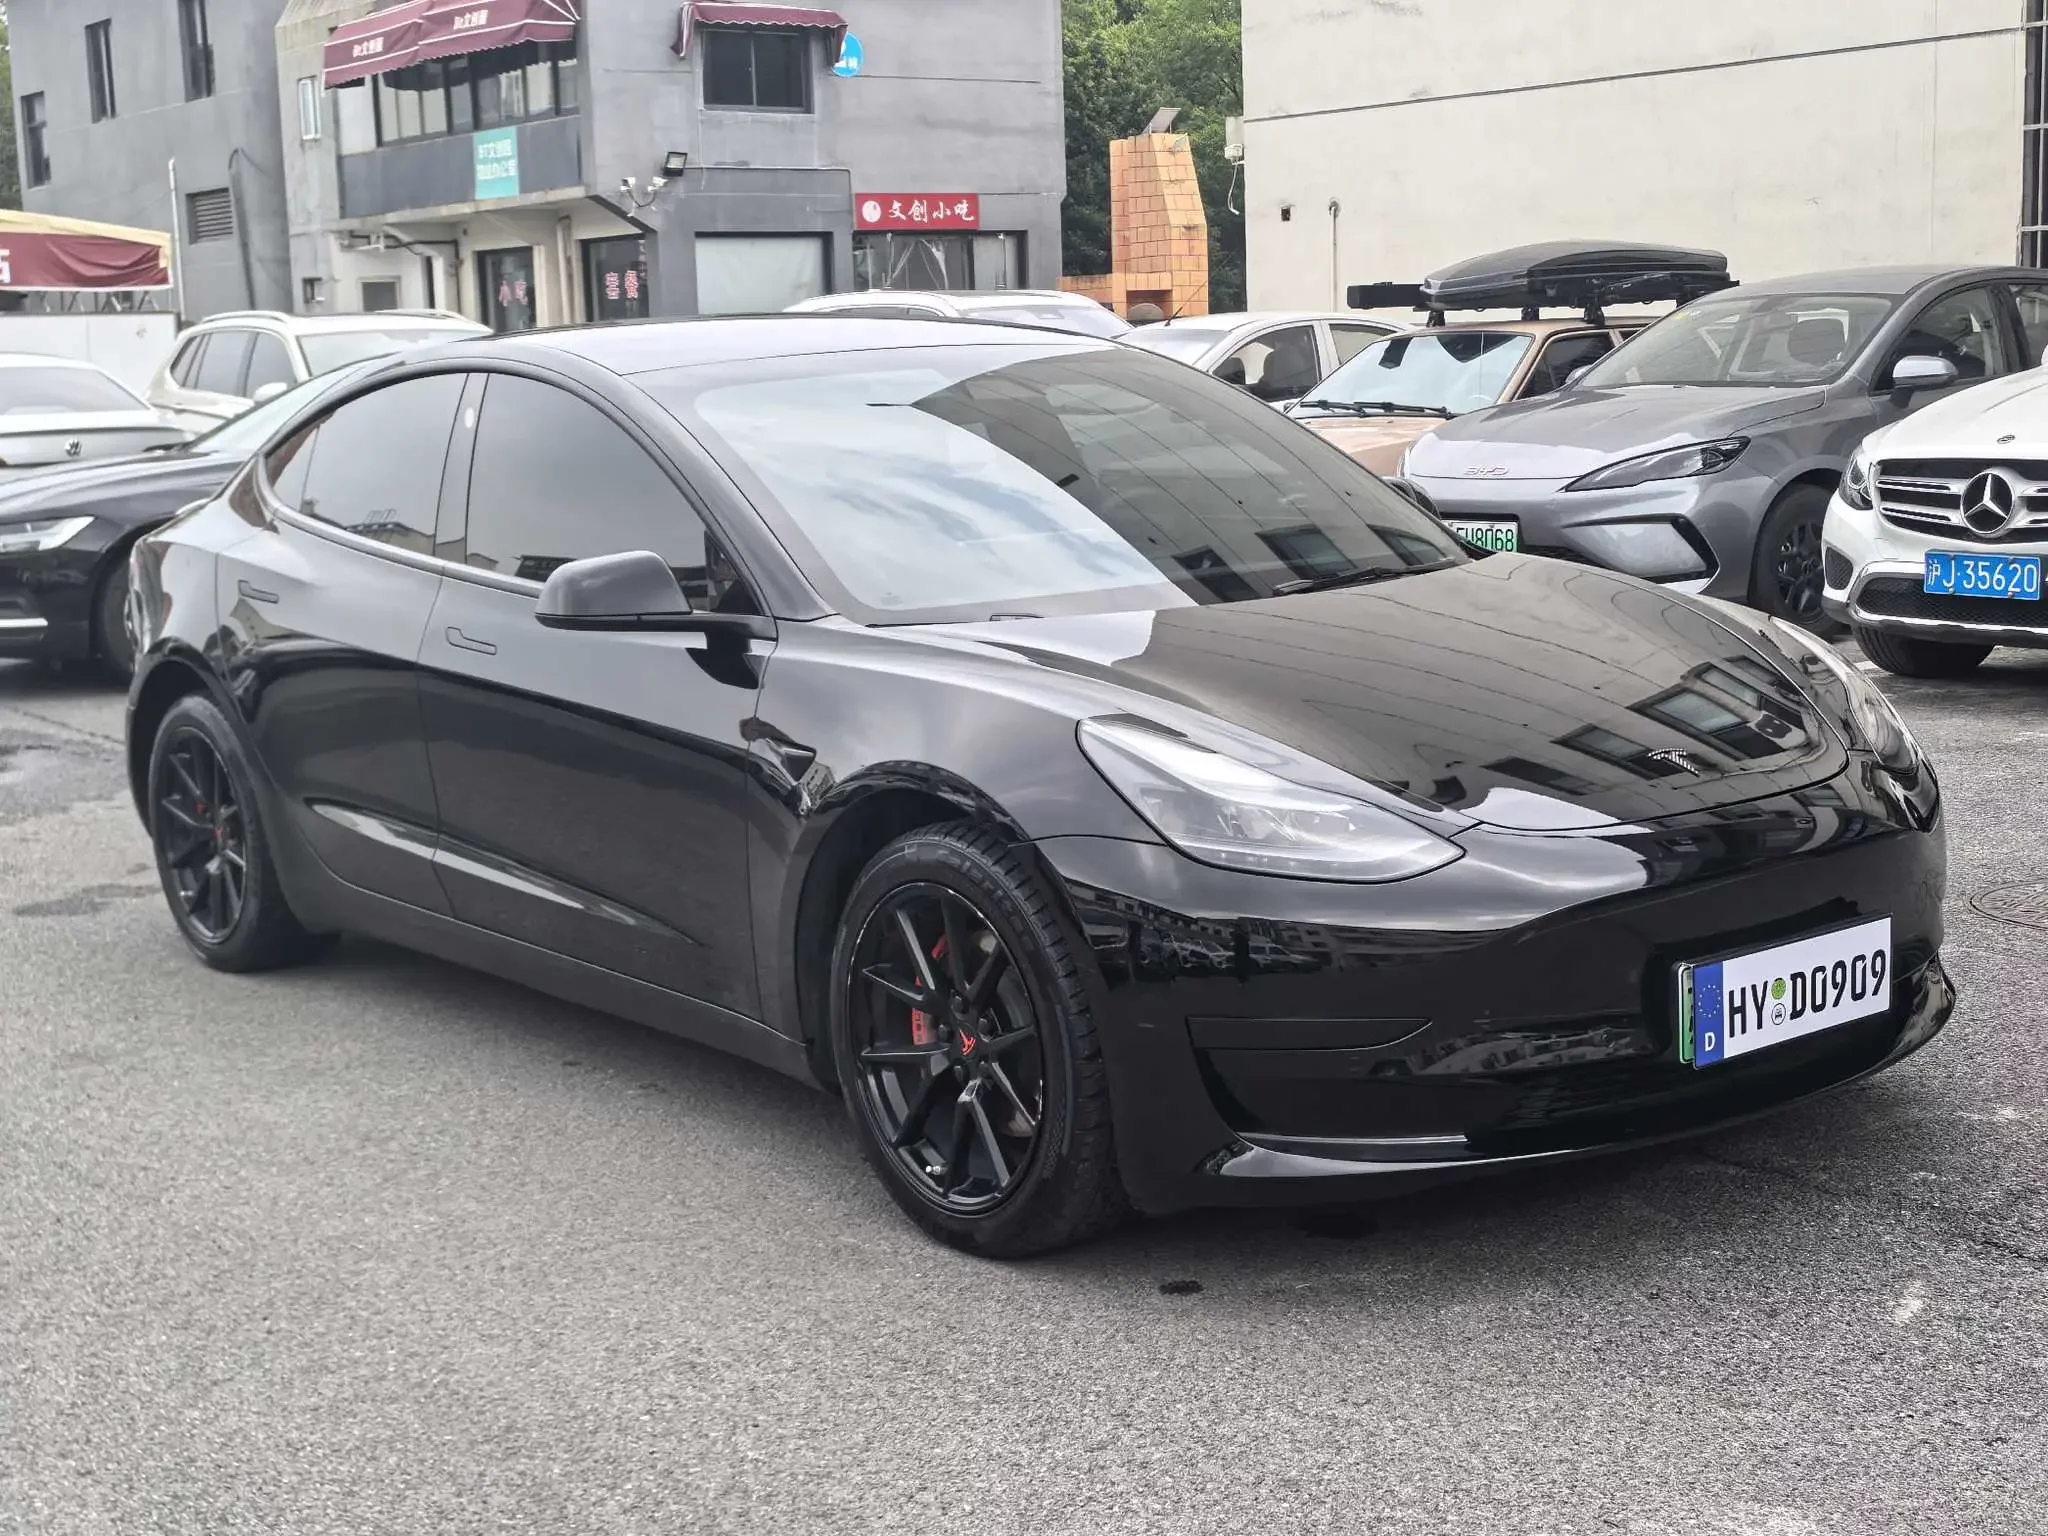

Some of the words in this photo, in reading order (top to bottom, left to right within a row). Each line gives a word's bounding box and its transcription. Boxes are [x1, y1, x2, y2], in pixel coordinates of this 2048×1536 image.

[888, 199, 975, 223] 文创小吃
[1704, 1031, 1716, 1052] D
